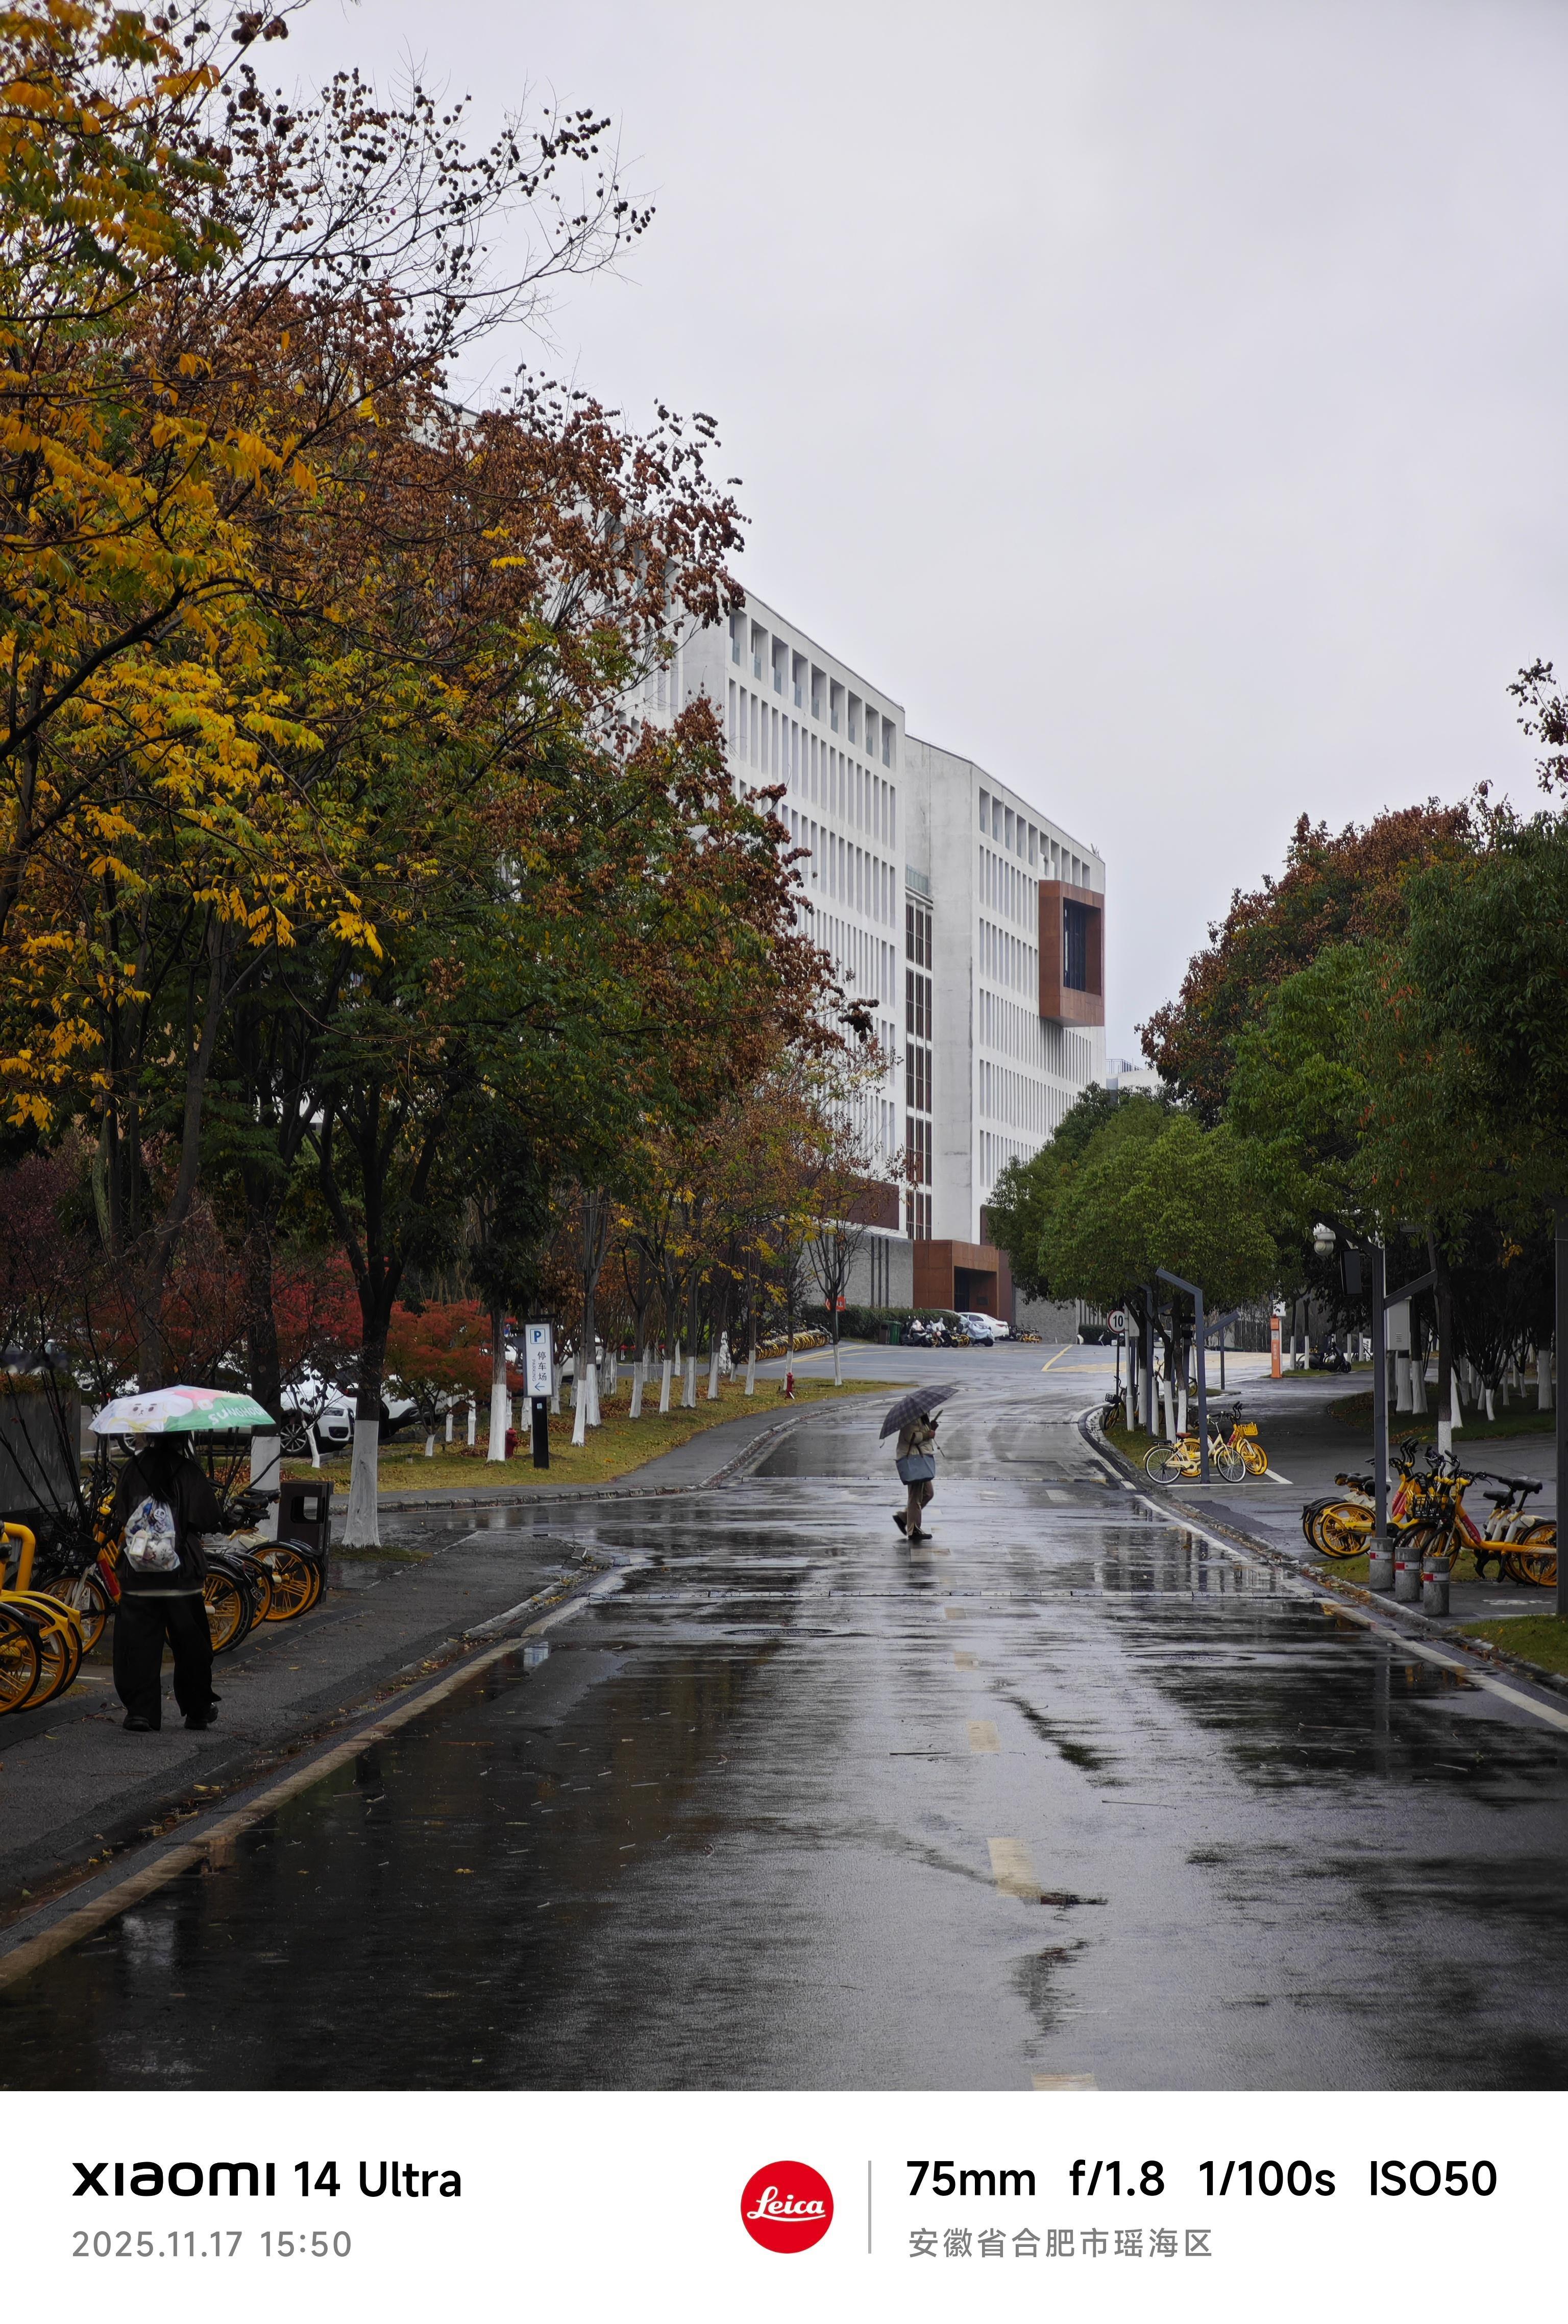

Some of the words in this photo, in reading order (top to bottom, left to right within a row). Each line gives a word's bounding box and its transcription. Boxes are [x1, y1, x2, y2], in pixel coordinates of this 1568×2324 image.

[1113, 1315, 1123, 1327] 10
[534, 1330, 542, 1342] P
[537, 1351, 546, 1381] 停车场
